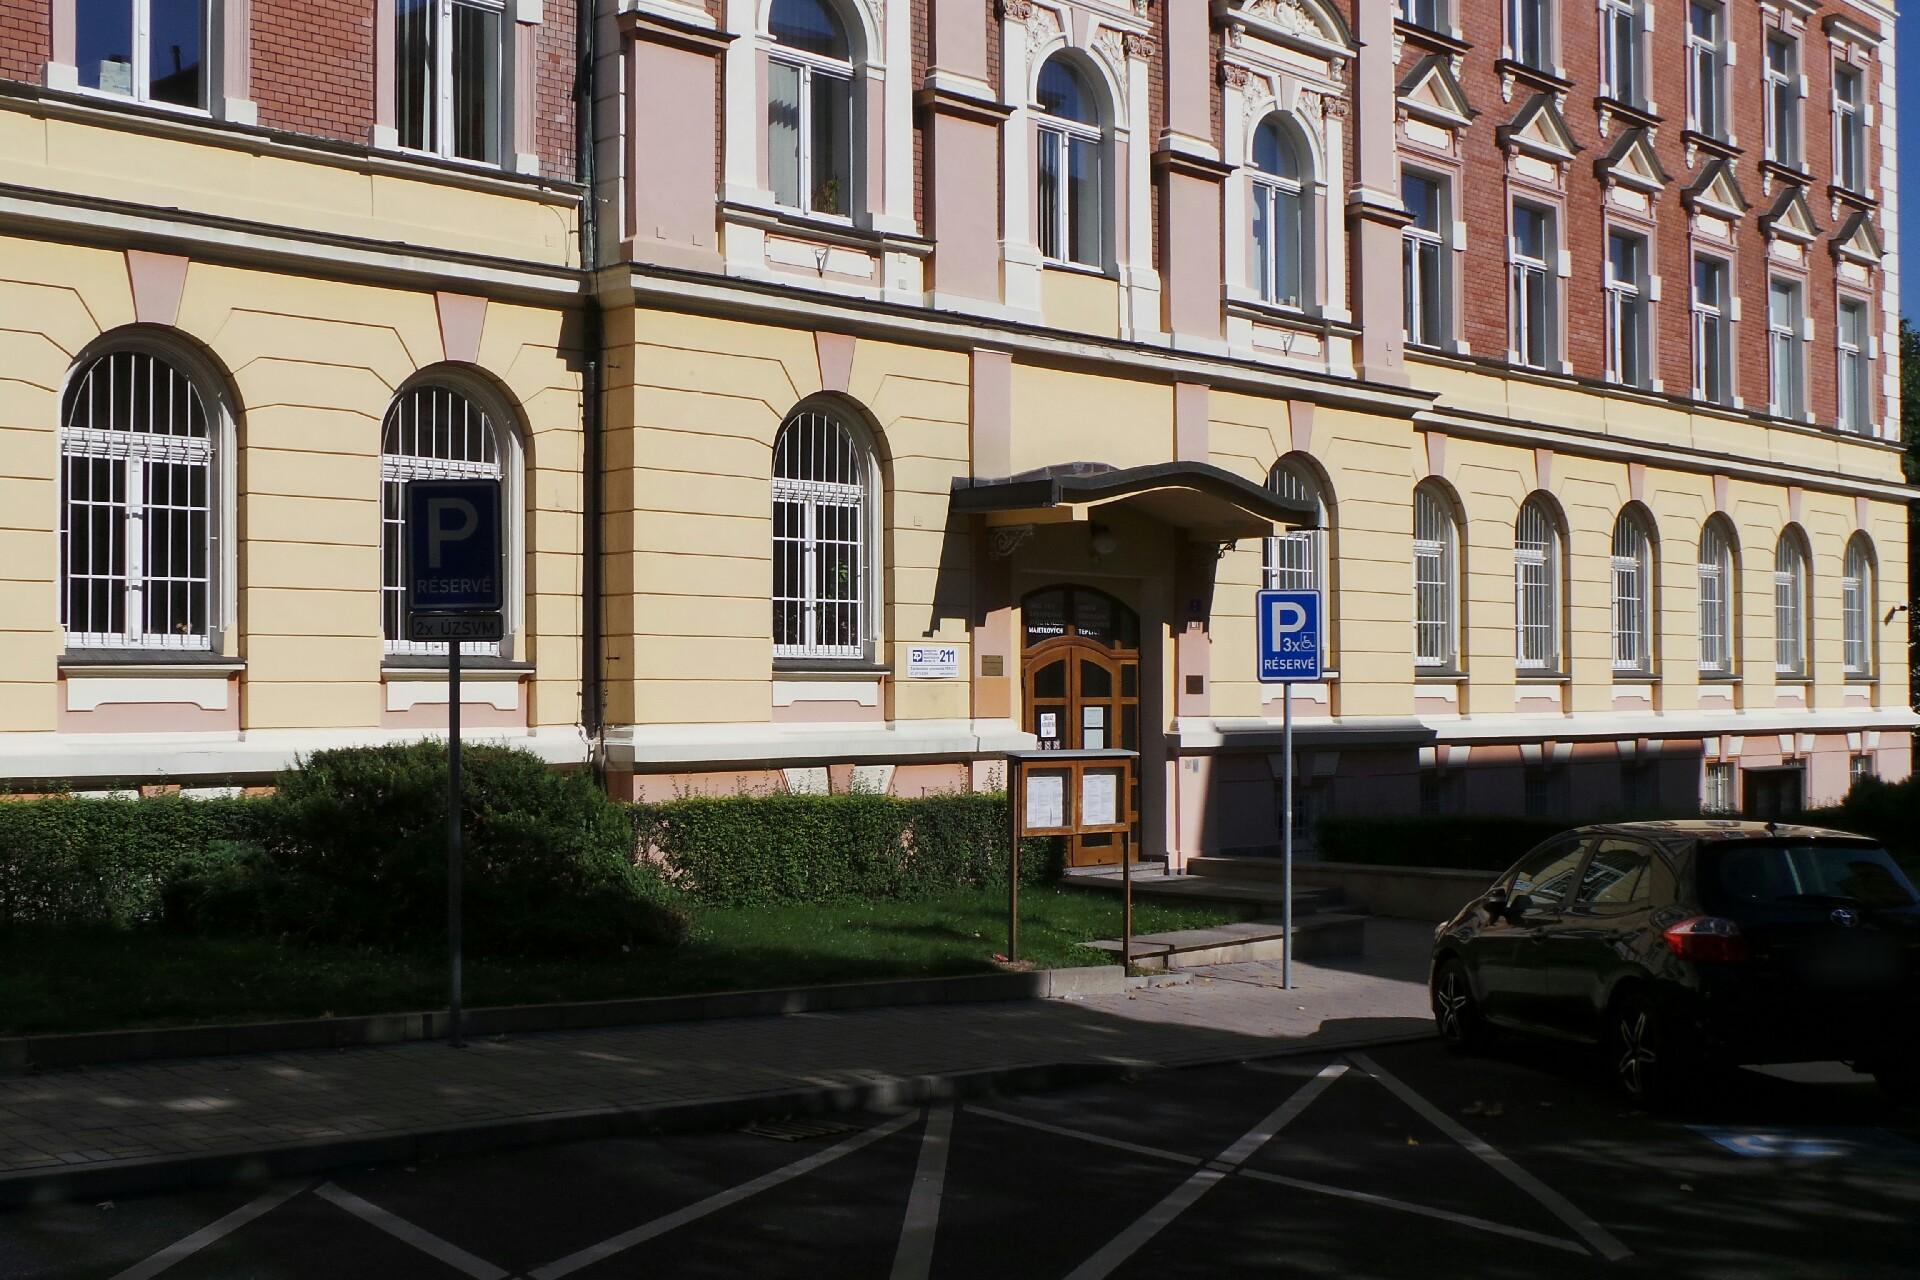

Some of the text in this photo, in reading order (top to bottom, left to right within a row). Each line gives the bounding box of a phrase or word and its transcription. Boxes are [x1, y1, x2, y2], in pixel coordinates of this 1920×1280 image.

[428, 498, 479, 568] P
[416, 576, 492, 593] RÉSERVÉ
[416, 619, 495, 636] 2x ÚZSVM
[1271, 602, 1307, 652] P
[1283, 637, 1300, 652] 3x
[939, 649, 955, 663] 211
[1264, 656, 1315, 669] RÉSERVÉ
